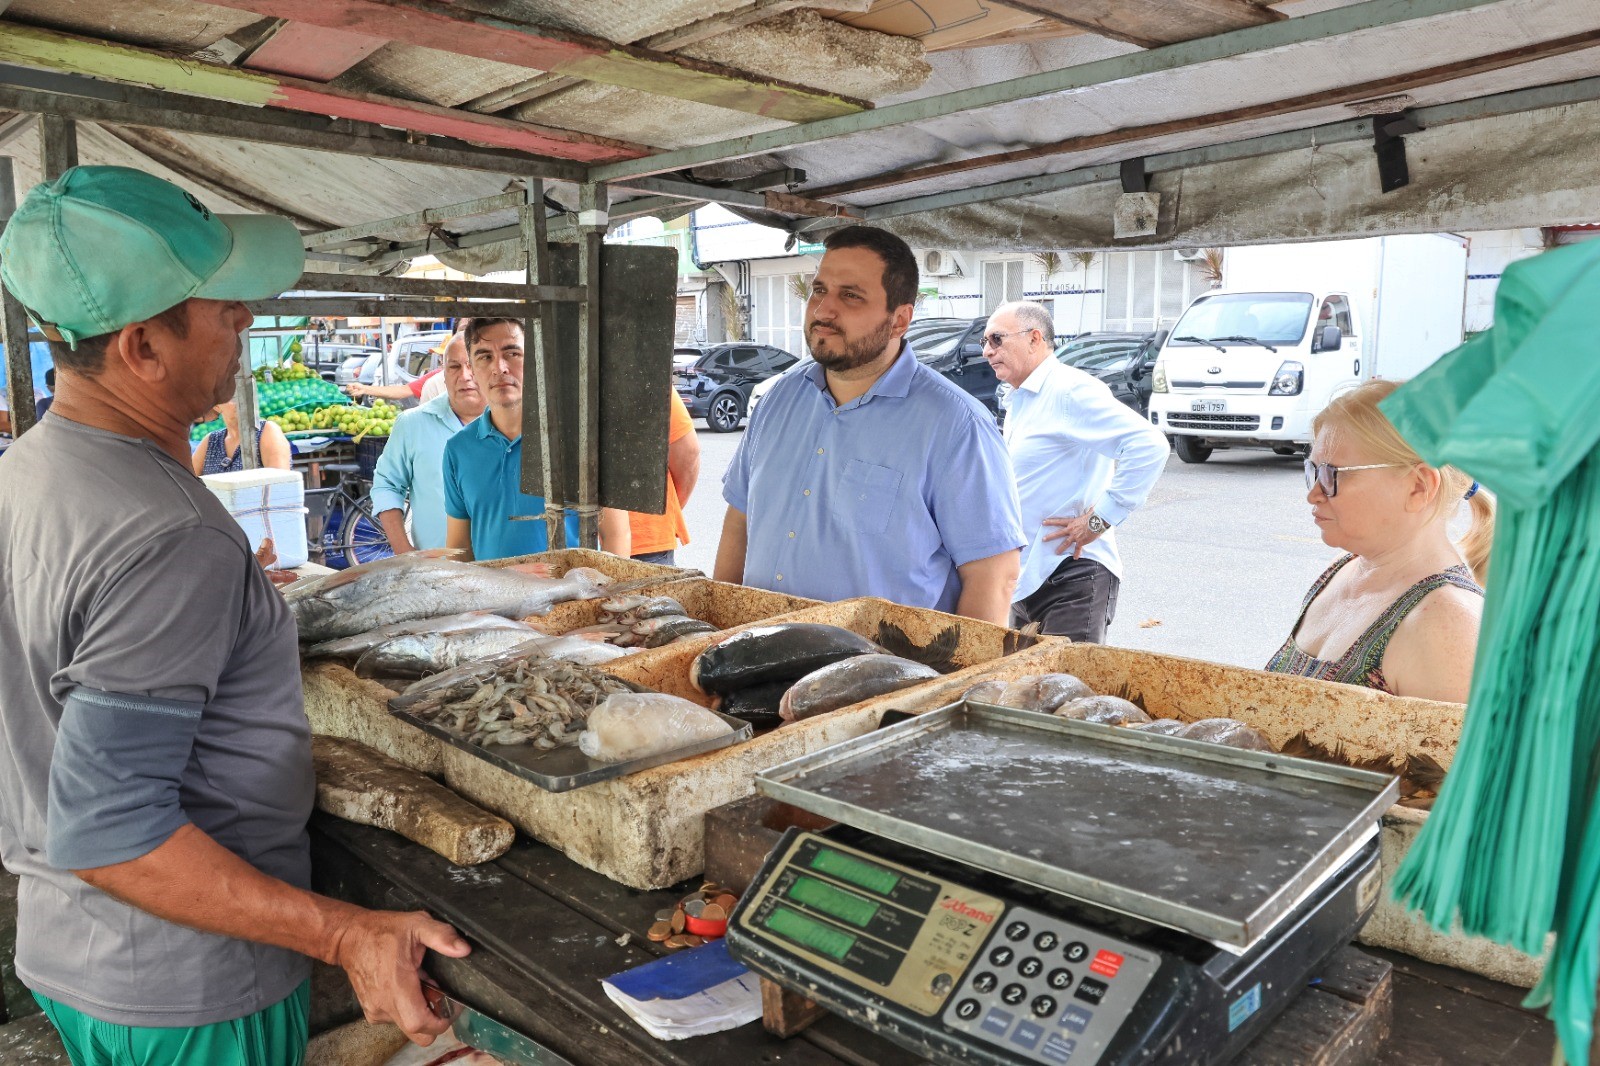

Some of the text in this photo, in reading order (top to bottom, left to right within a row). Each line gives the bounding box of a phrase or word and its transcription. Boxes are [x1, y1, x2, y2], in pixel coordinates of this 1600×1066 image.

[952, 899, 994, 924] Urano
[939, 915, 977, 937] POP Z
[1012, 925, 1025, 936] 7
[1040, 936, 1053, 947] 8
[996, 952, 1009, 963] 4
[1069, 946, 1082, 958] 9
[1024, 961, 1038, 973] 5
[979, 975, 991, 987] 1
[1054, 973, 1068, 985] 6
[1007, 988, 1021, 1001] 2
[960, 1003, 974, 1015] 0
[1037, 1000, 1051, 1013] 3
